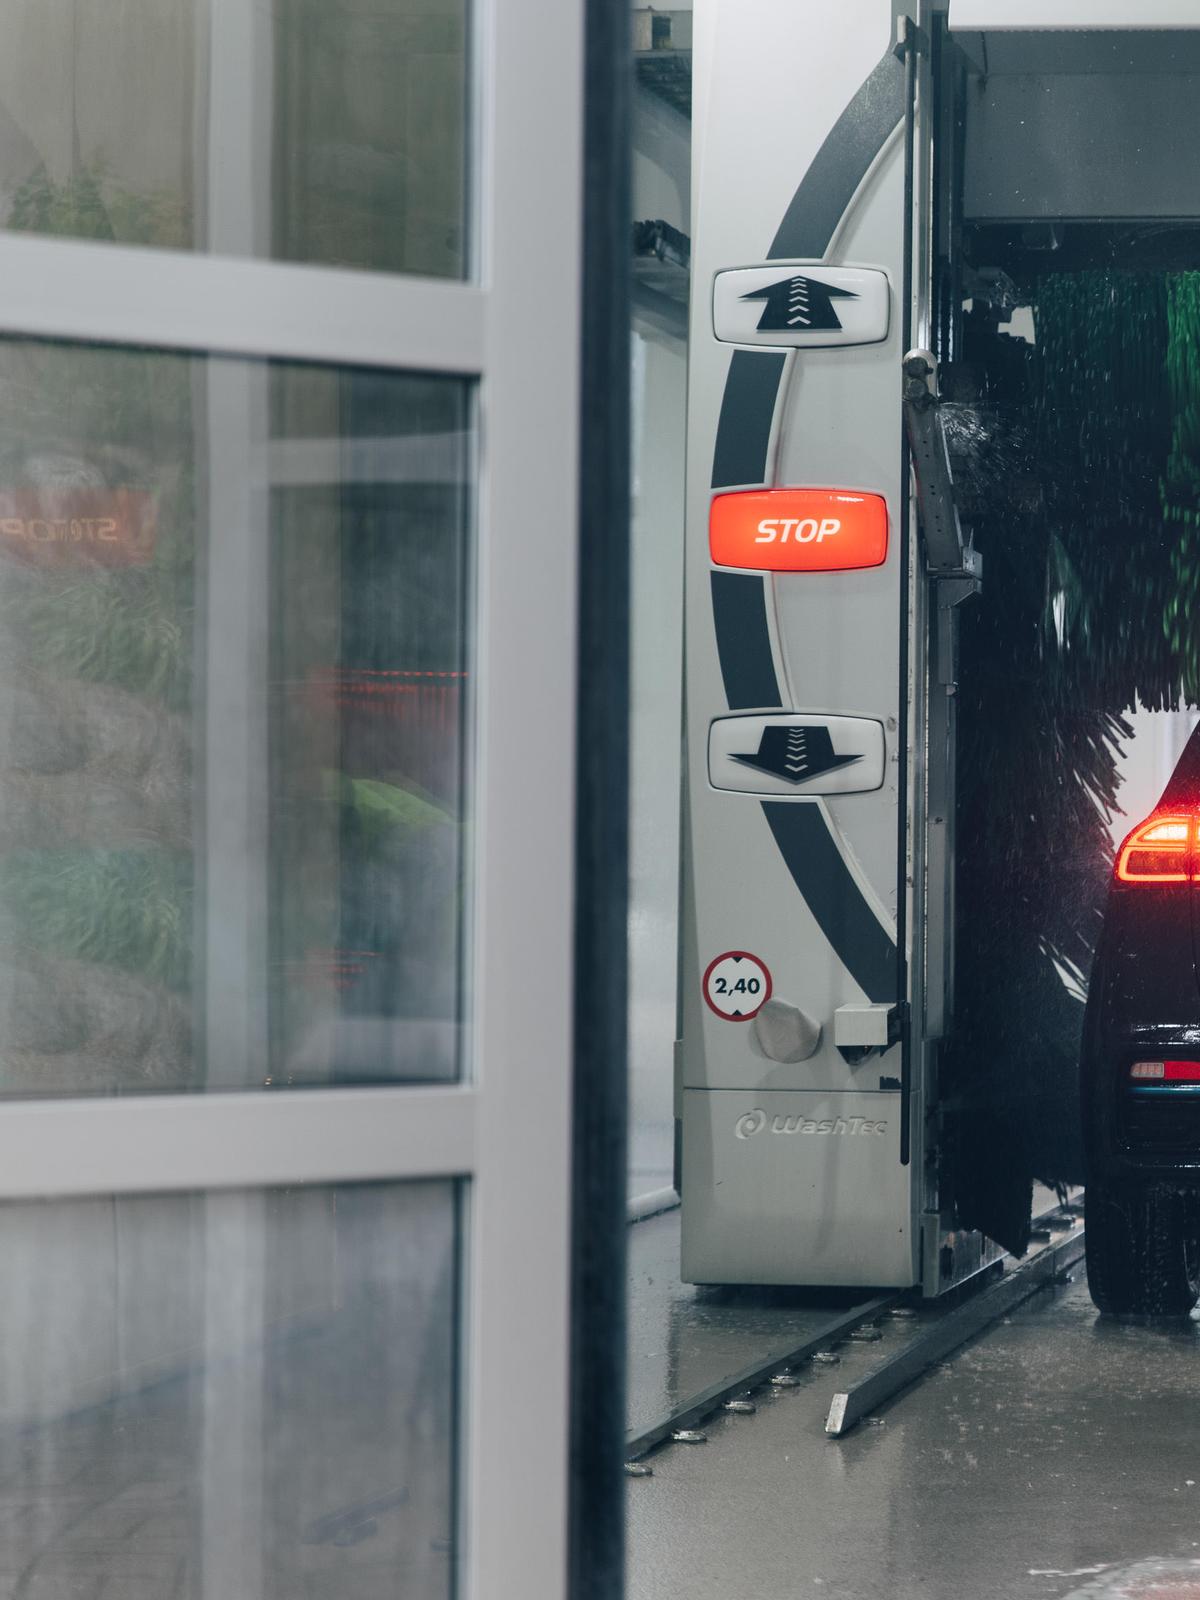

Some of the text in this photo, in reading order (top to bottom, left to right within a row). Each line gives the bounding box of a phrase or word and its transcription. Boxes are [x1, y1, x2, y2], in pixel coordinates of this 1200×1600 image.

[754, 518, 841, 543] STOP
[715, 977, 761, 997] 2,40
[770, 1114, 889, 1136] WashTec
